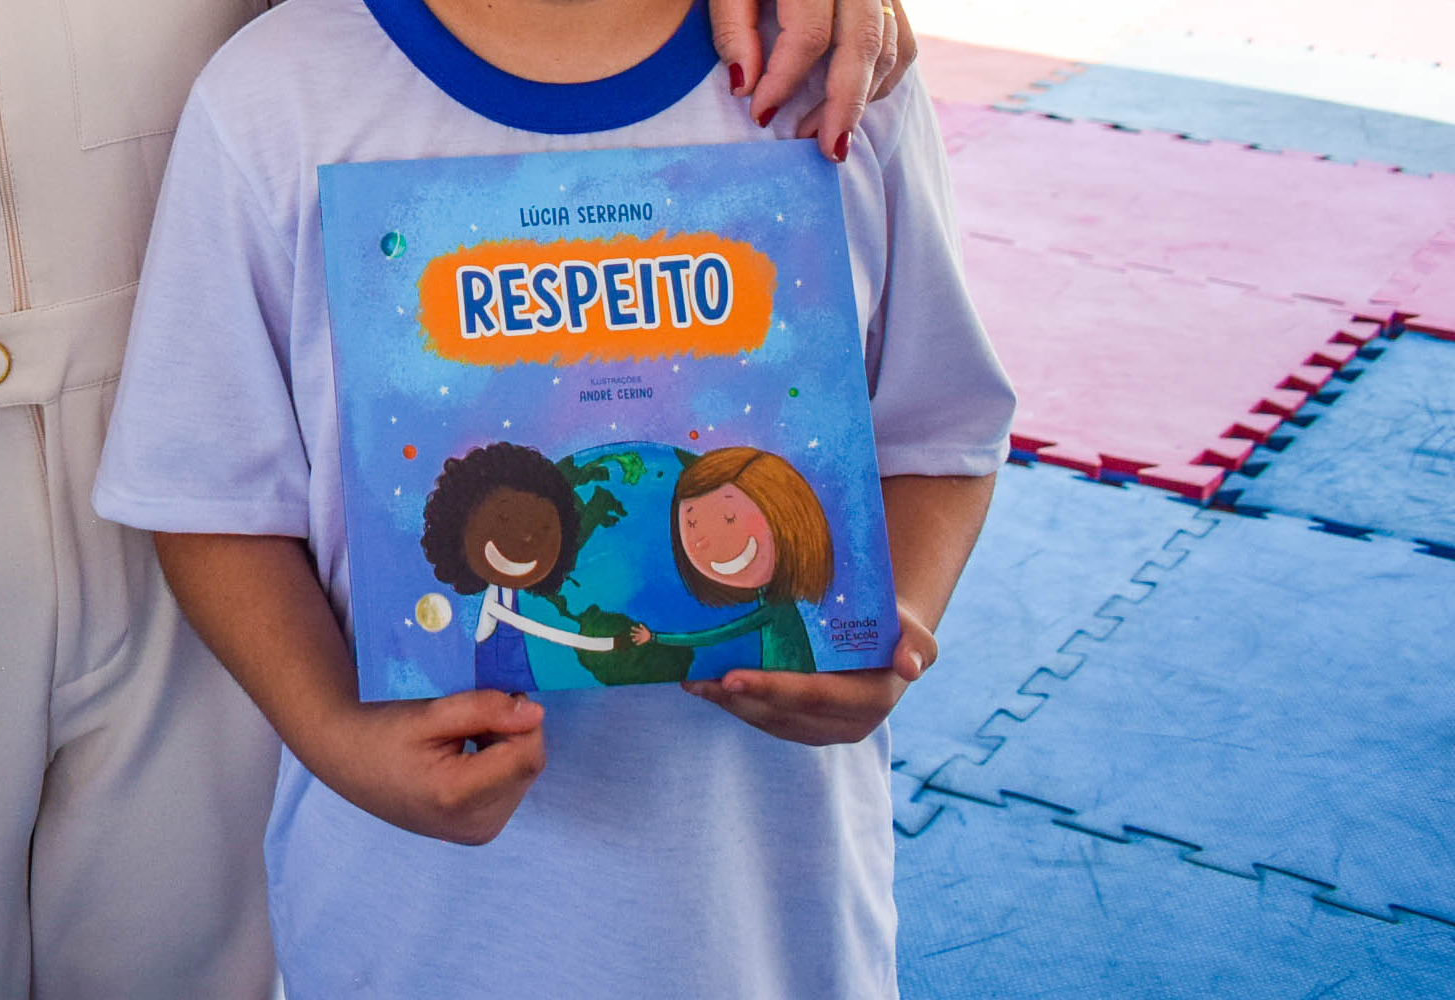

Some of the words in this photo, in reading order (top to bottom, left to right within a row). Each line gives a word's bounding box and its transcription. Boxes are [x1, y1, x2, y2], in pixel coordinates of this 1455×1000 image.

[519, 204, 570, 227] LÚCIA
[577, 202, 653, 224] SERRANO
[456, 252, 734, 340] RESPEITO
[590, 375, 642, 386] ILUSTRAÇÕES
[579, 388, 614, 403] ANDRÉ
[617, 387, 653, 400] CERINO
[830, 616, 877, 629] Ciranda
[845, 629, 879, 641] Escola
